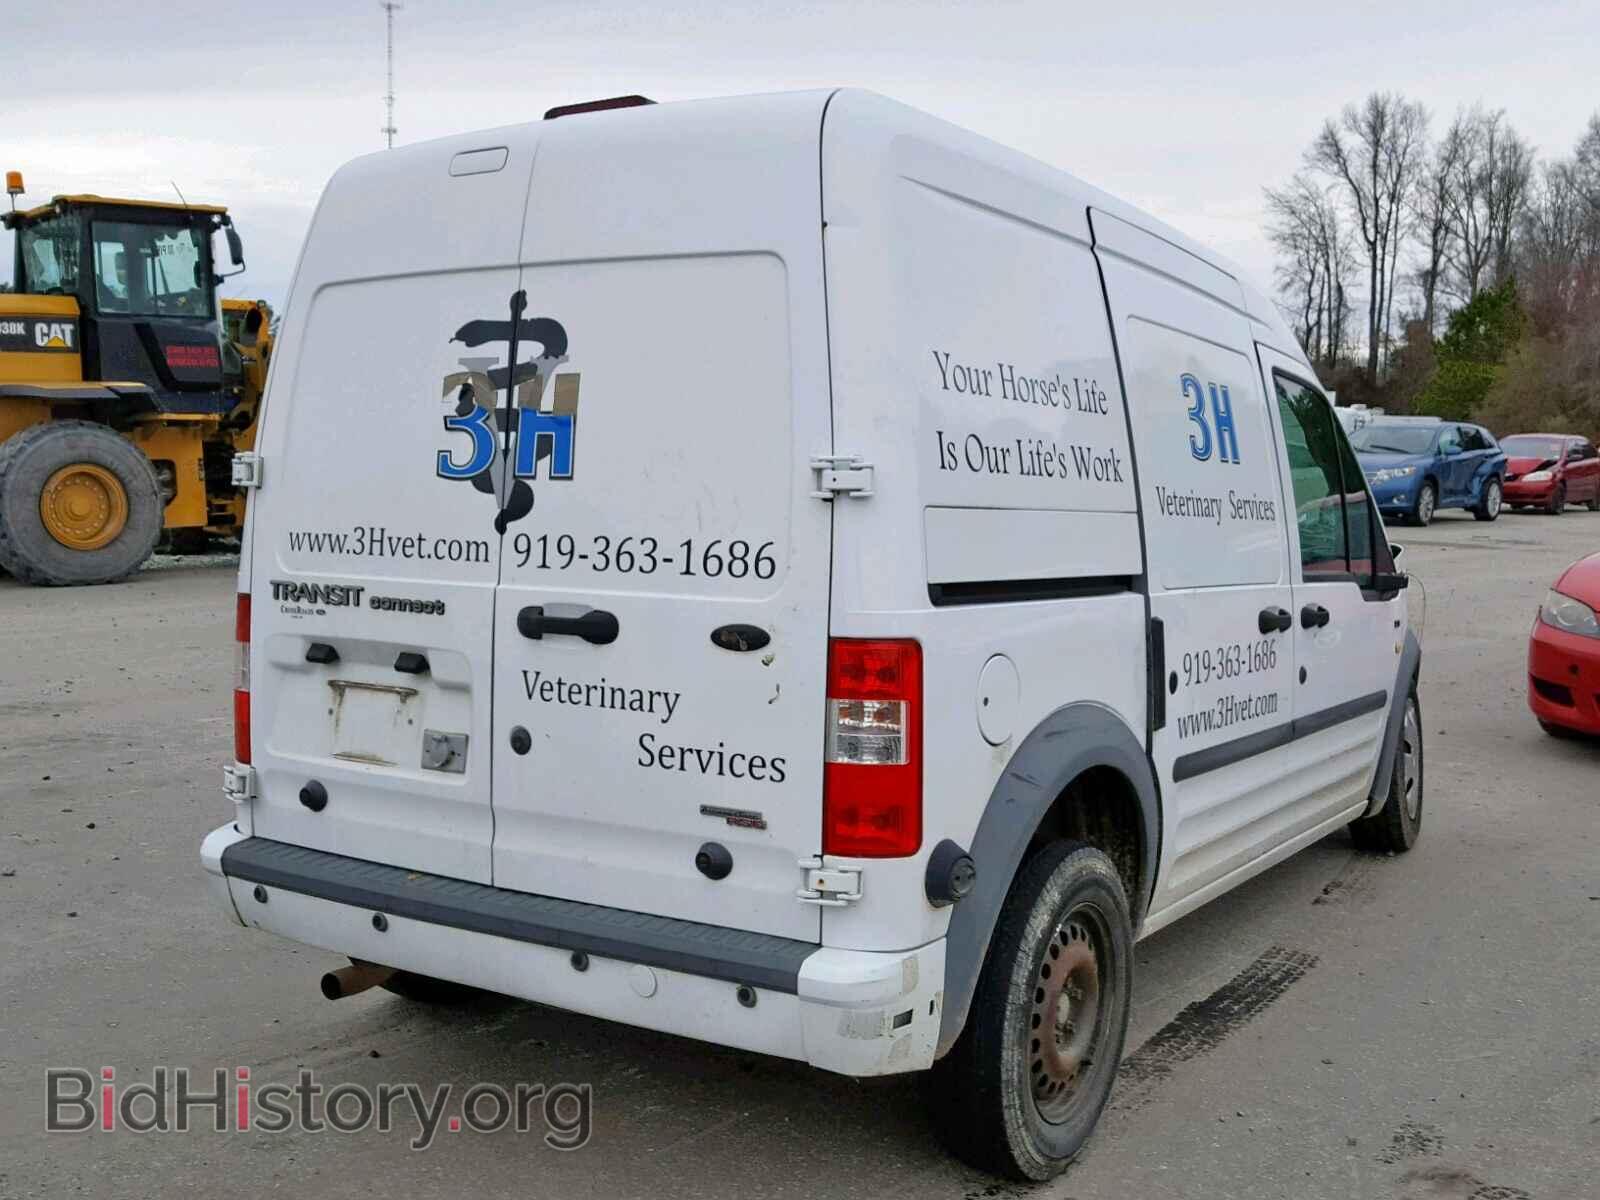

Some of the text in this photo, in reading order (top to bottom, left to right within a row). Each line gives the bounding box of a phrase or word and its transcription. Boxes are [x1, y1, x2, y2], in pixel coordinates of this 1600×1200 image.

[0, 322, 26, 335] 30K
[34, 322, 75, 347] CAT
[932, 350, 1109, 415] Your Horse's Life
[436, 372, 581, 481] 3H
[1180, 372, 1241, 465] 3H
[936, 430, 1124, 482] Is Our Life's Work
[1156, 486, 1276, 526] Veterinary Services
[288, 526, 490, 563] www.3Hvet.com
[513, 533, 777, 580] 919-363-1686
[270, 580, 446, 616] TRANSIT connect
[1183, 639, 1276, 686] 919-363-1686
[521, 670, 681, 724] Veterinary
[1177, 692, 1278, 739] www.3Hvet.com
[637, 733, 787, 783] Services
